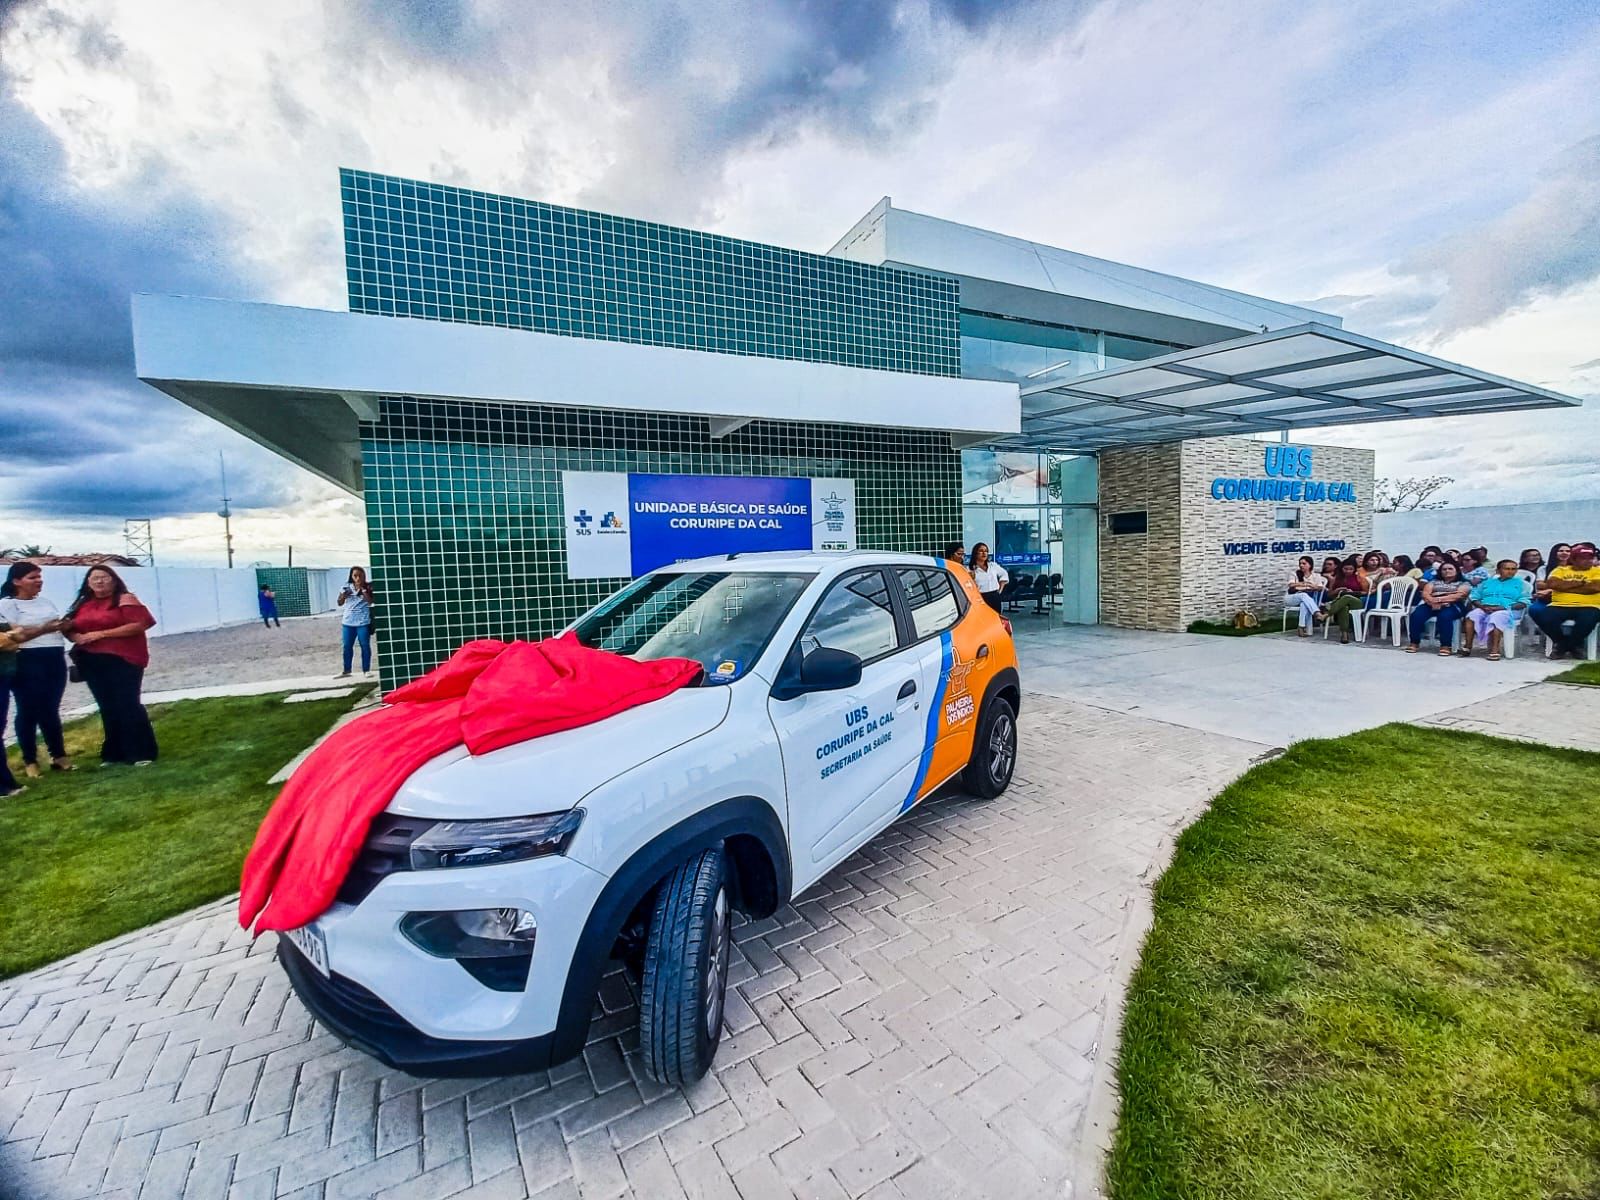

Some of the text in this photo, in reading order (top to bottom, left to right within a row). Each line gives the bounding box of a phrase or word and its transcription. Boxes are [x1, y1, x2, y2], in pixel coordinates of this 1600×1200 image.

[1264, 445, 1313, 478] UBS
[1211, 477, 1358, 503] CORURIPE DA CAL
[634, 501, 808, 515] UNIDADE BÁSICA DE SAÚDE
[670, 518, 782, 529] CORURIPE DA CAL
[1223, 542, 1268, 556] VICENTE
[1271, 541, 1305, 554] GOMES
[845, 705, 869, 727] UBS
[816, 711, 895, 760] CORURIPE DA CAL
[820, 748, 863, 780] SECRETARIA
[863, 743, 872, 755] DA
